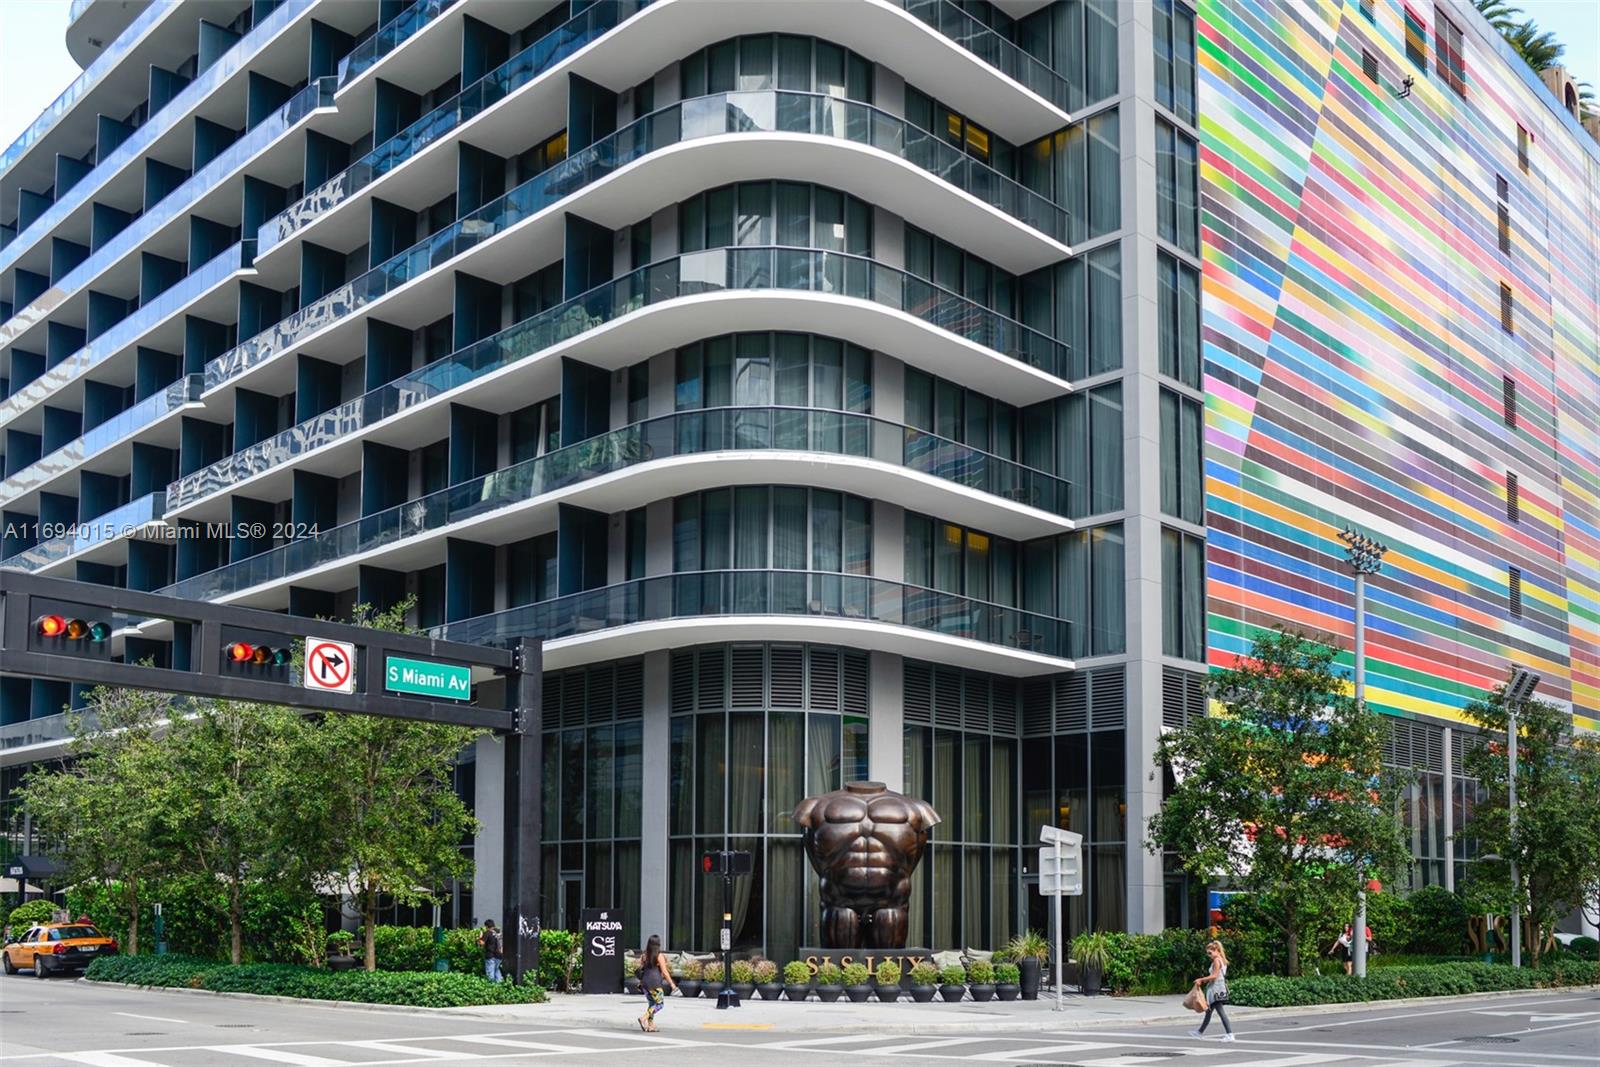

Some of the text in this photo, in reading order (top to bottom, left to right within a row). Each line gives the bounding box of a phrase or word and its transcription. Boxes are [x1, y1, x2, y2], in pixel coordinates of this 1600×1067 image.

[388, 666, 467, 691] S Miami Av
[586, 921, 622, 930] KATSUYA
[591, 935, 616, 957] S BAR
